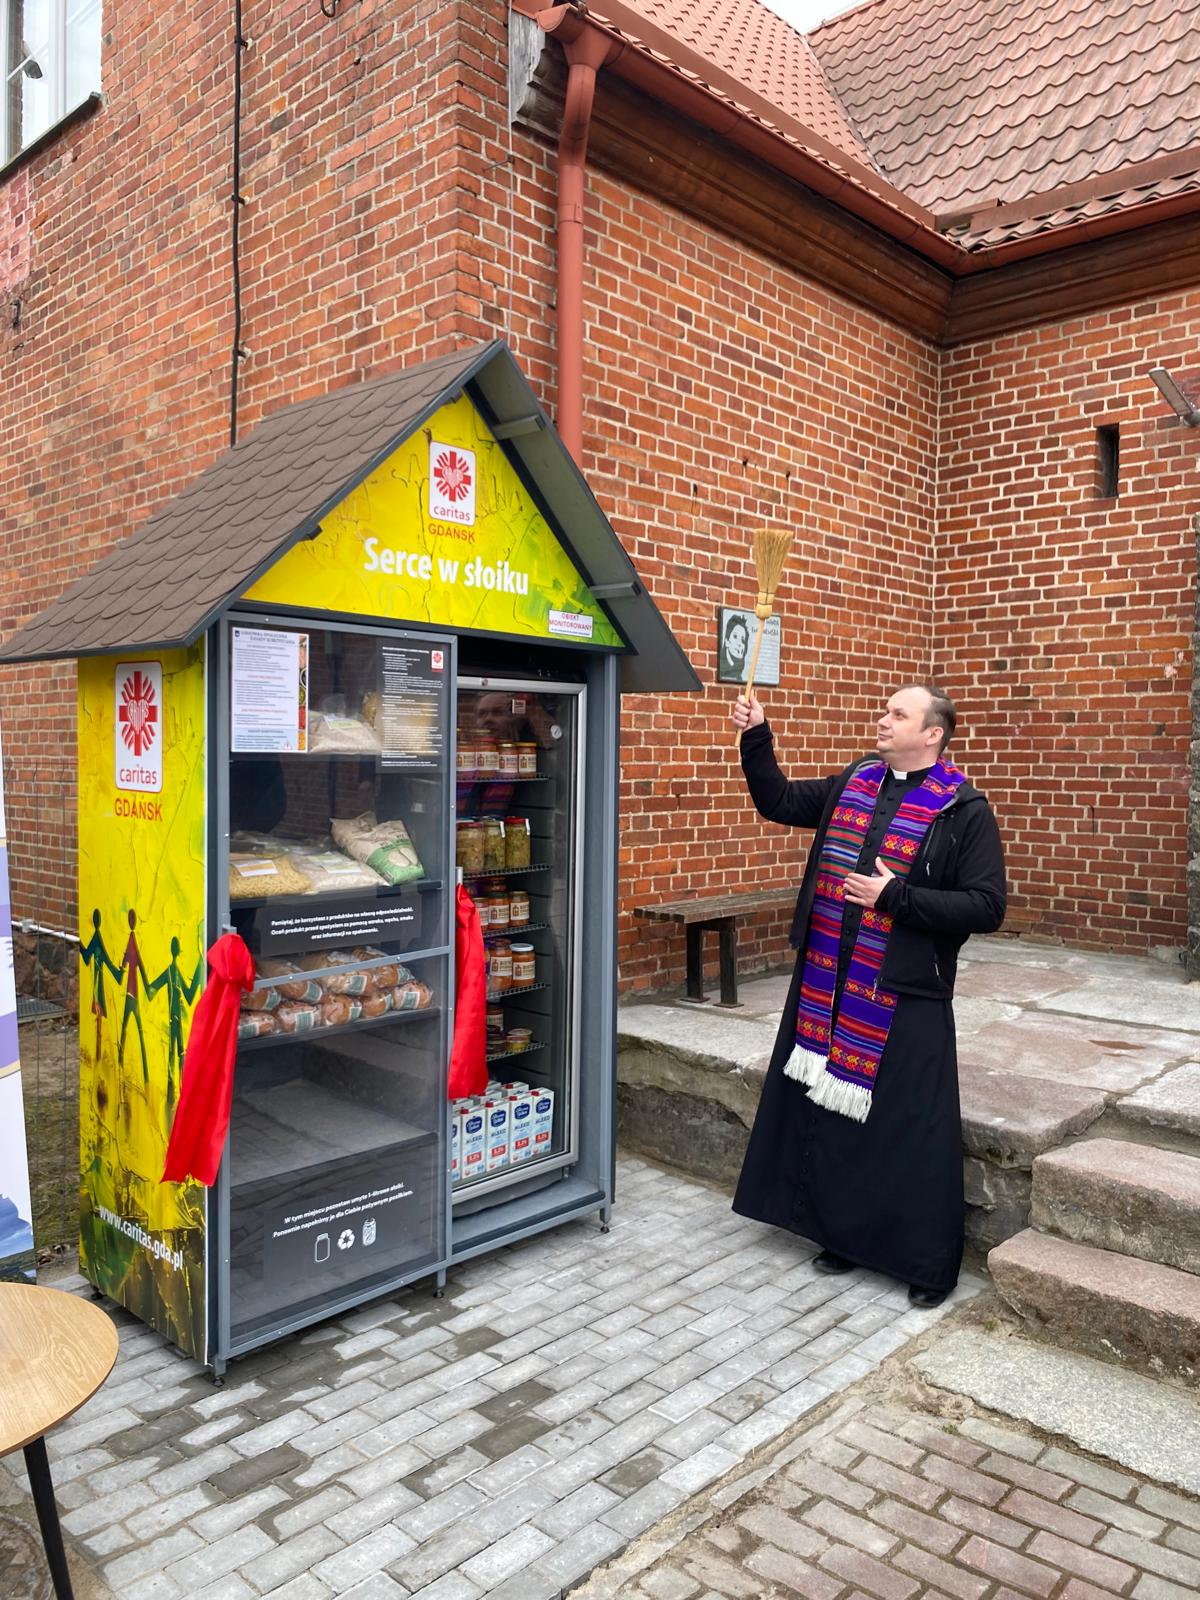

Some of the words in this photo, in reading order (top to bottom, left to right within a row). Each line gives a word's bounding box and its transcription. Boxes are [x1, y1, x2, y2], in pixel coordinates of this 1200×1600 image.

[433, 504, 471, 522] caritas
[428, 522, 476, 542] GDAŃSK
[364, 537, 432, 580] Serce
[438, 559, 458, 584] w
[464, 556, 528, 595] słoiku
[119, 763, 158, 785] caritas
[114, 796, 162, 822] GDAŃSK
[272, 1225, 301, 1238] Ponownie
[344, 1206, 361, 1215] Ciebie
[99, 1204, 184, 1272] www.caritas.gda.pl
